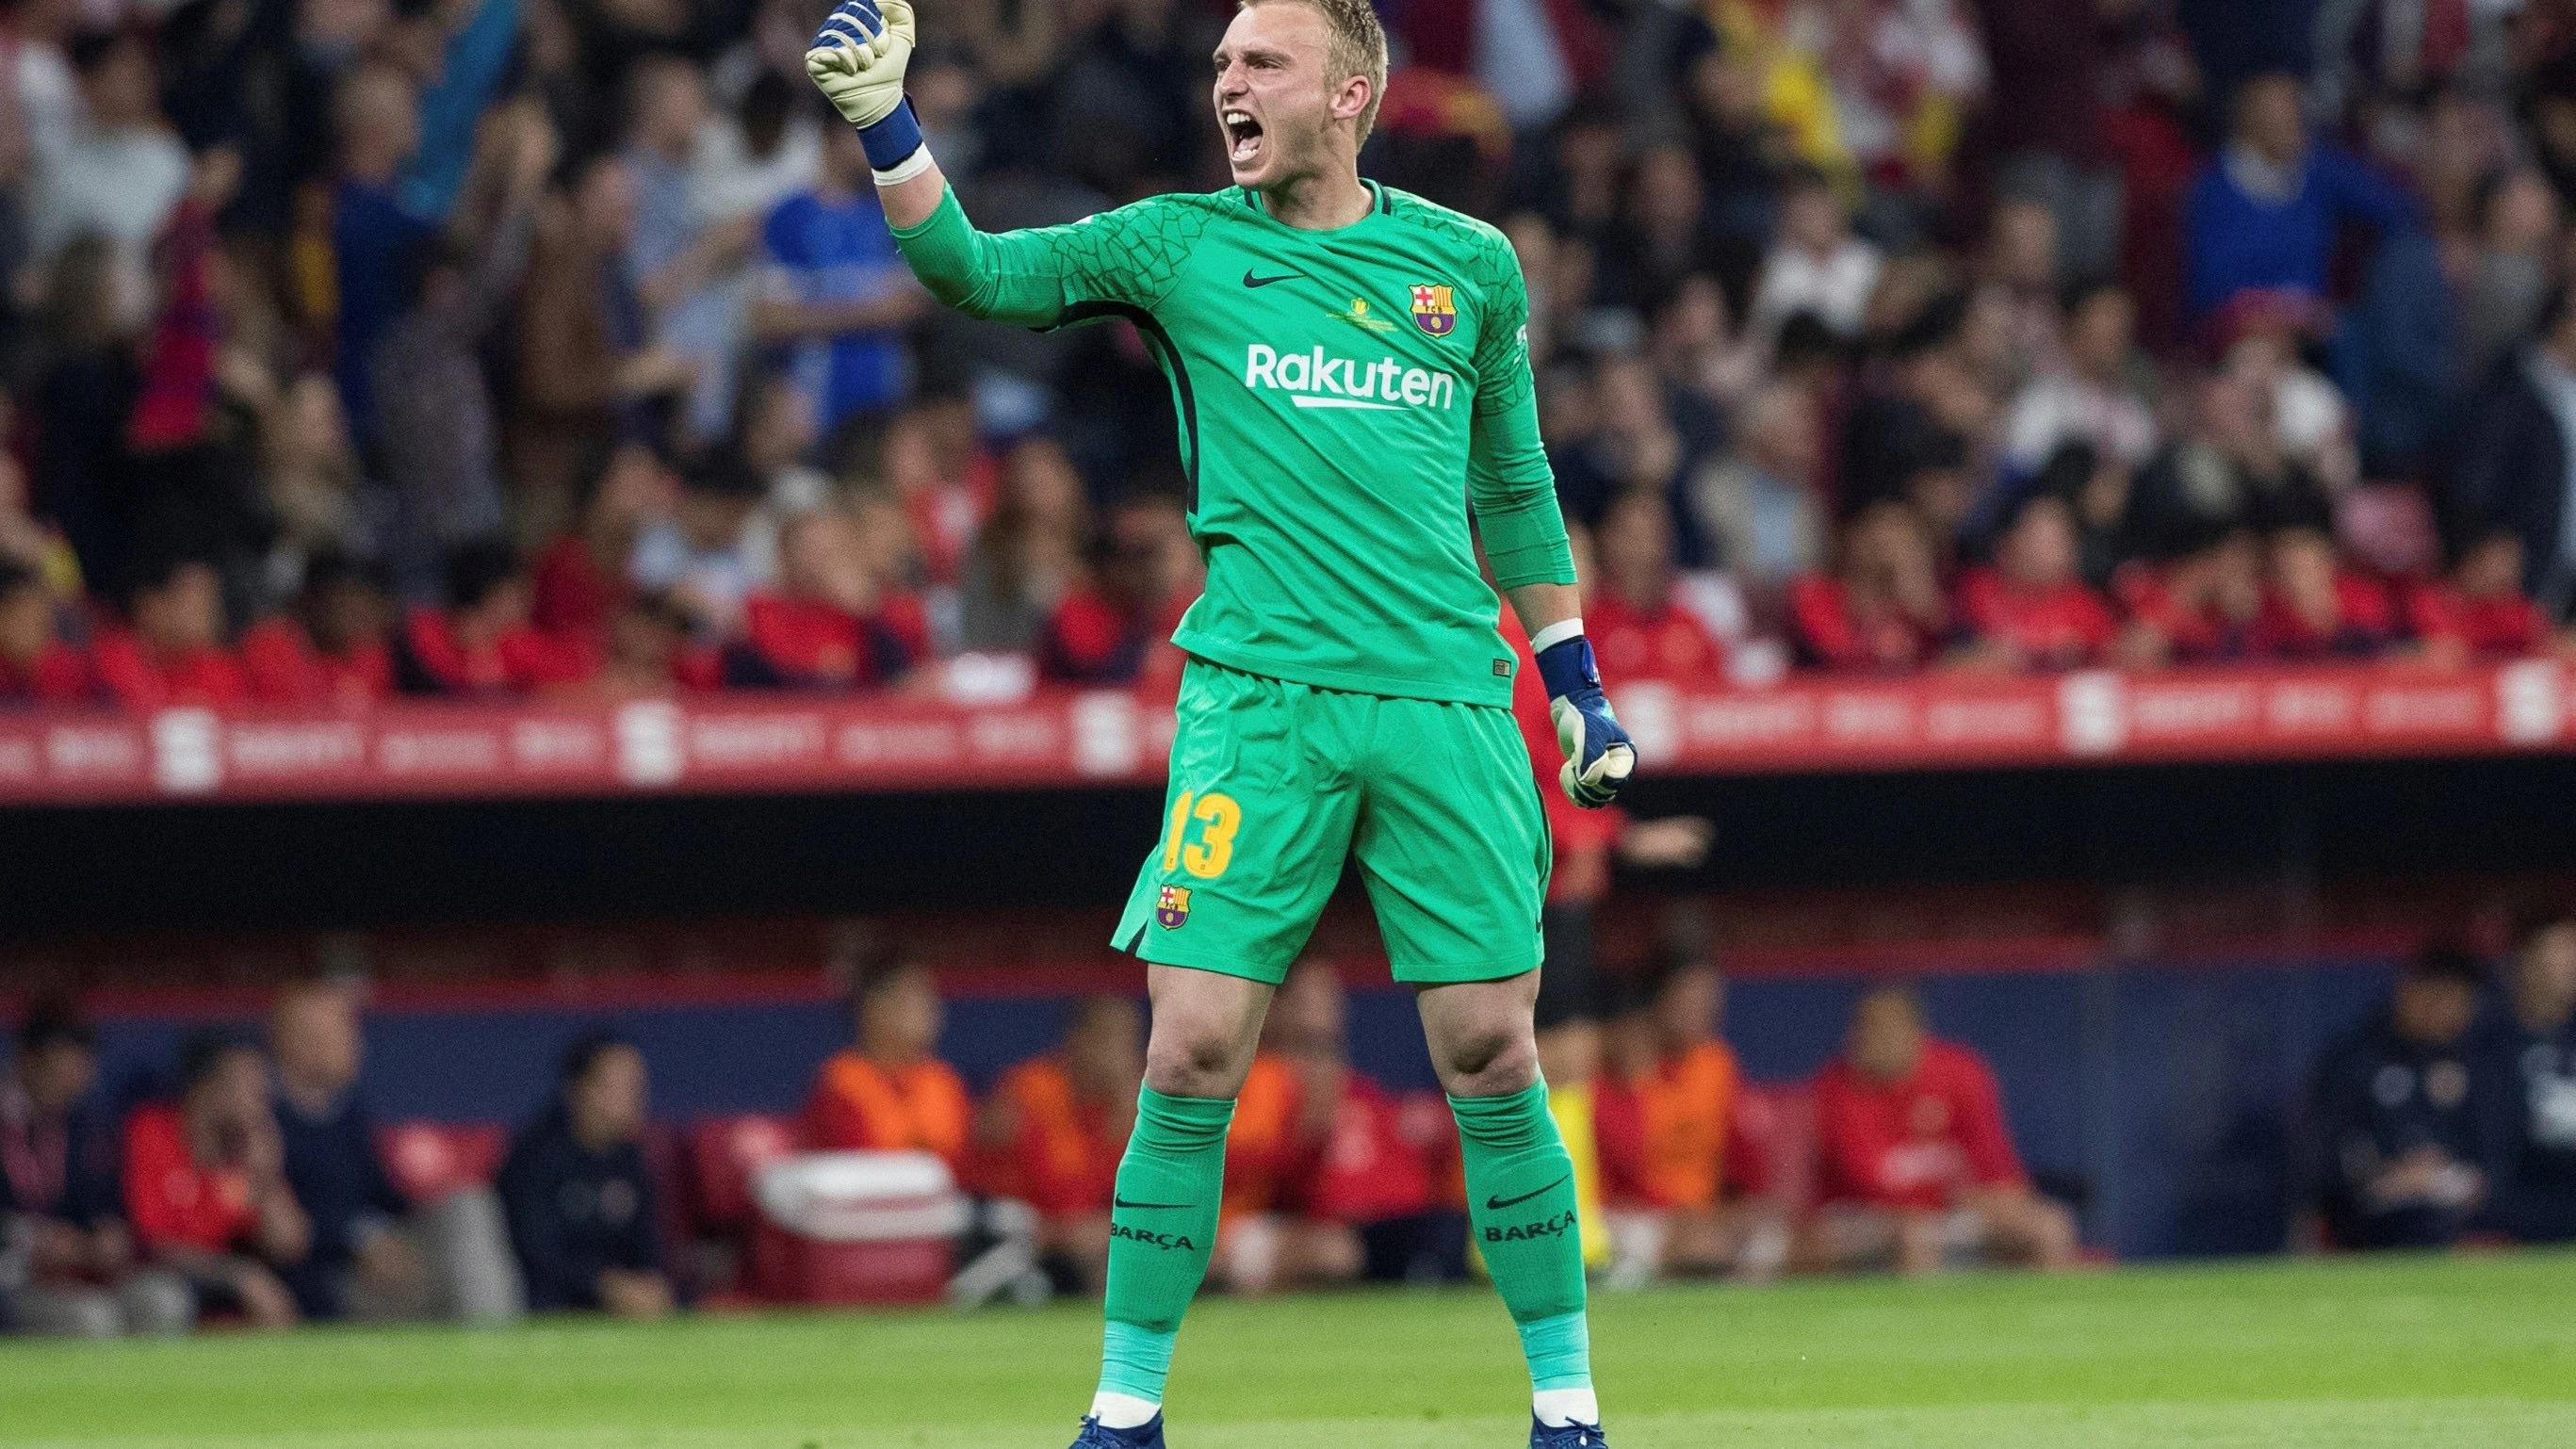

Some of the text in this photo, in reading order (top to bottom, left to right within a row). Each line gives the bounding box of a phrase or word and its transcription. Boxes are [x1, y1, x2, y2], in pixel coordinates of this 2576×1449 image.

[1246, 344, 1453, 409] Rakuten
[1163, 790, 1242, 879] 13
[1111, 1223, 1195, 1251] BARÇA
[1485, 1210, 1576, 1242] BARÇA
